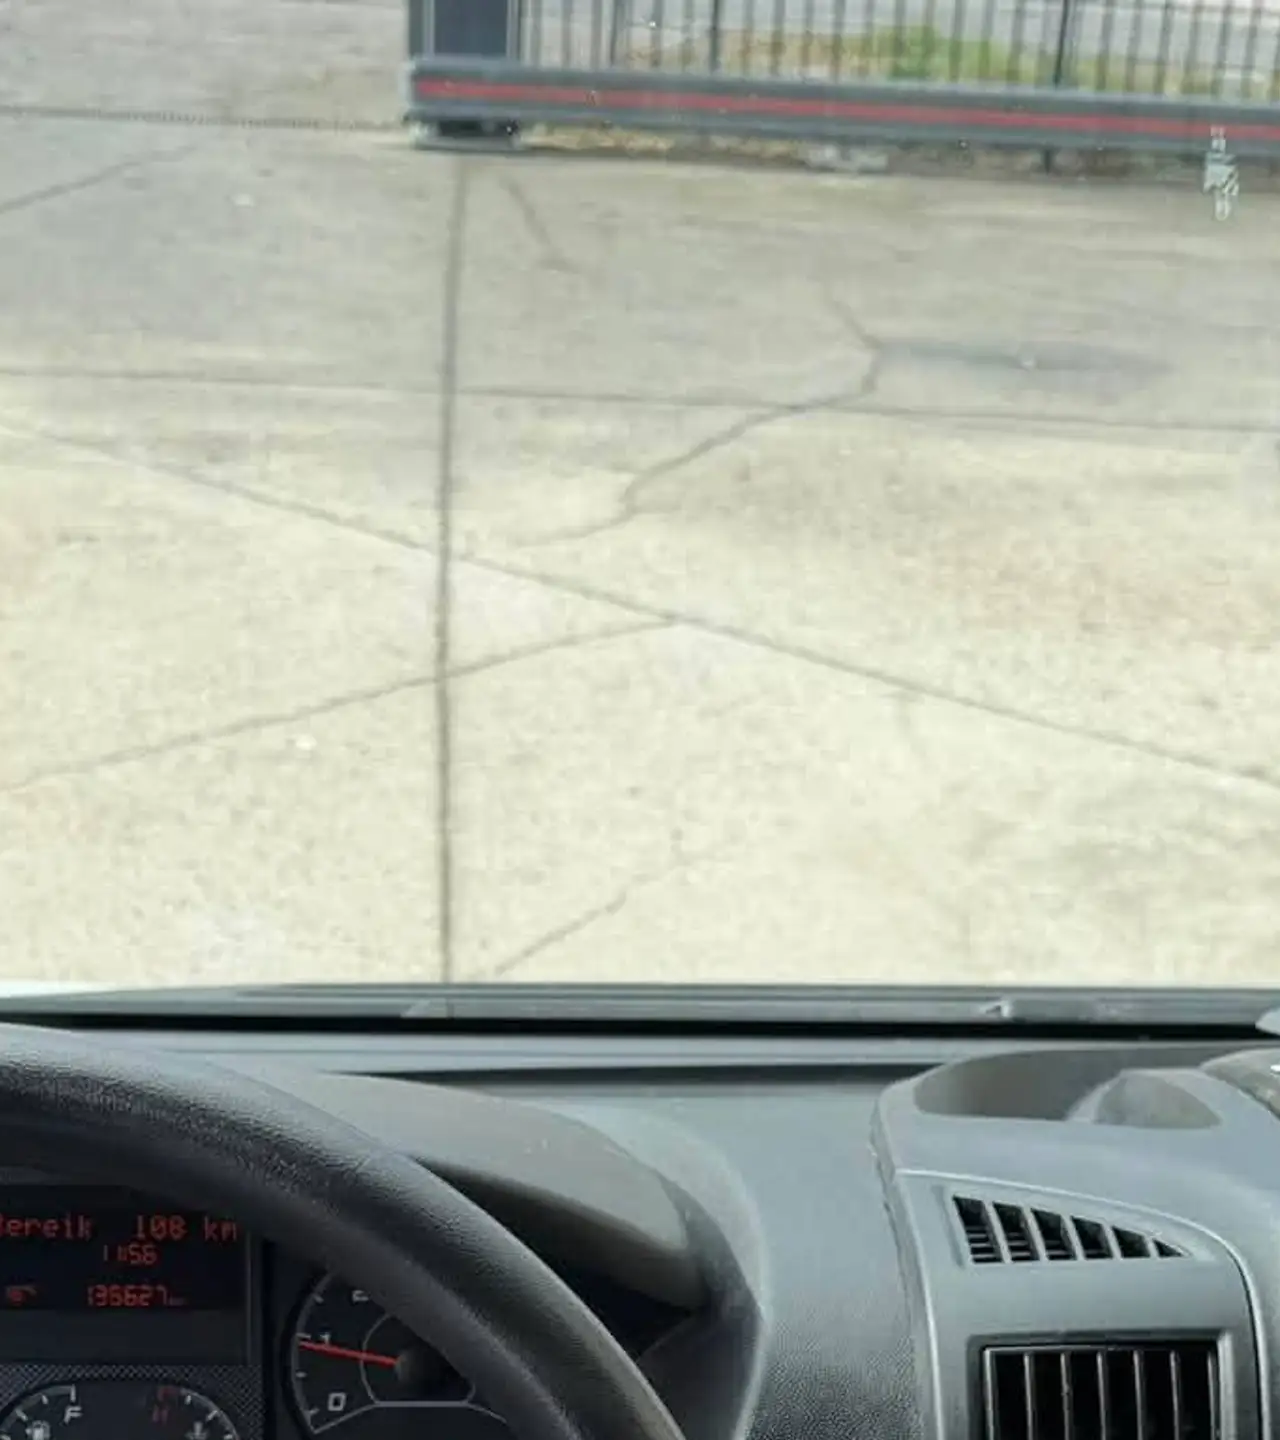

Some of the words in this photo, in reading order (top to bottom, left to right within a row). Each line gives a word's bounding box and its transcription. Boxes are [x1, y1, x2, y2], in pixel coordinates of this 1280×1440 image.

[135, 1213, 188, 1241] 108
[204, 1214, 239, 1241] km
[327, 1392, 347, 1412] 0
[64, 1405, 83, 1426] F
